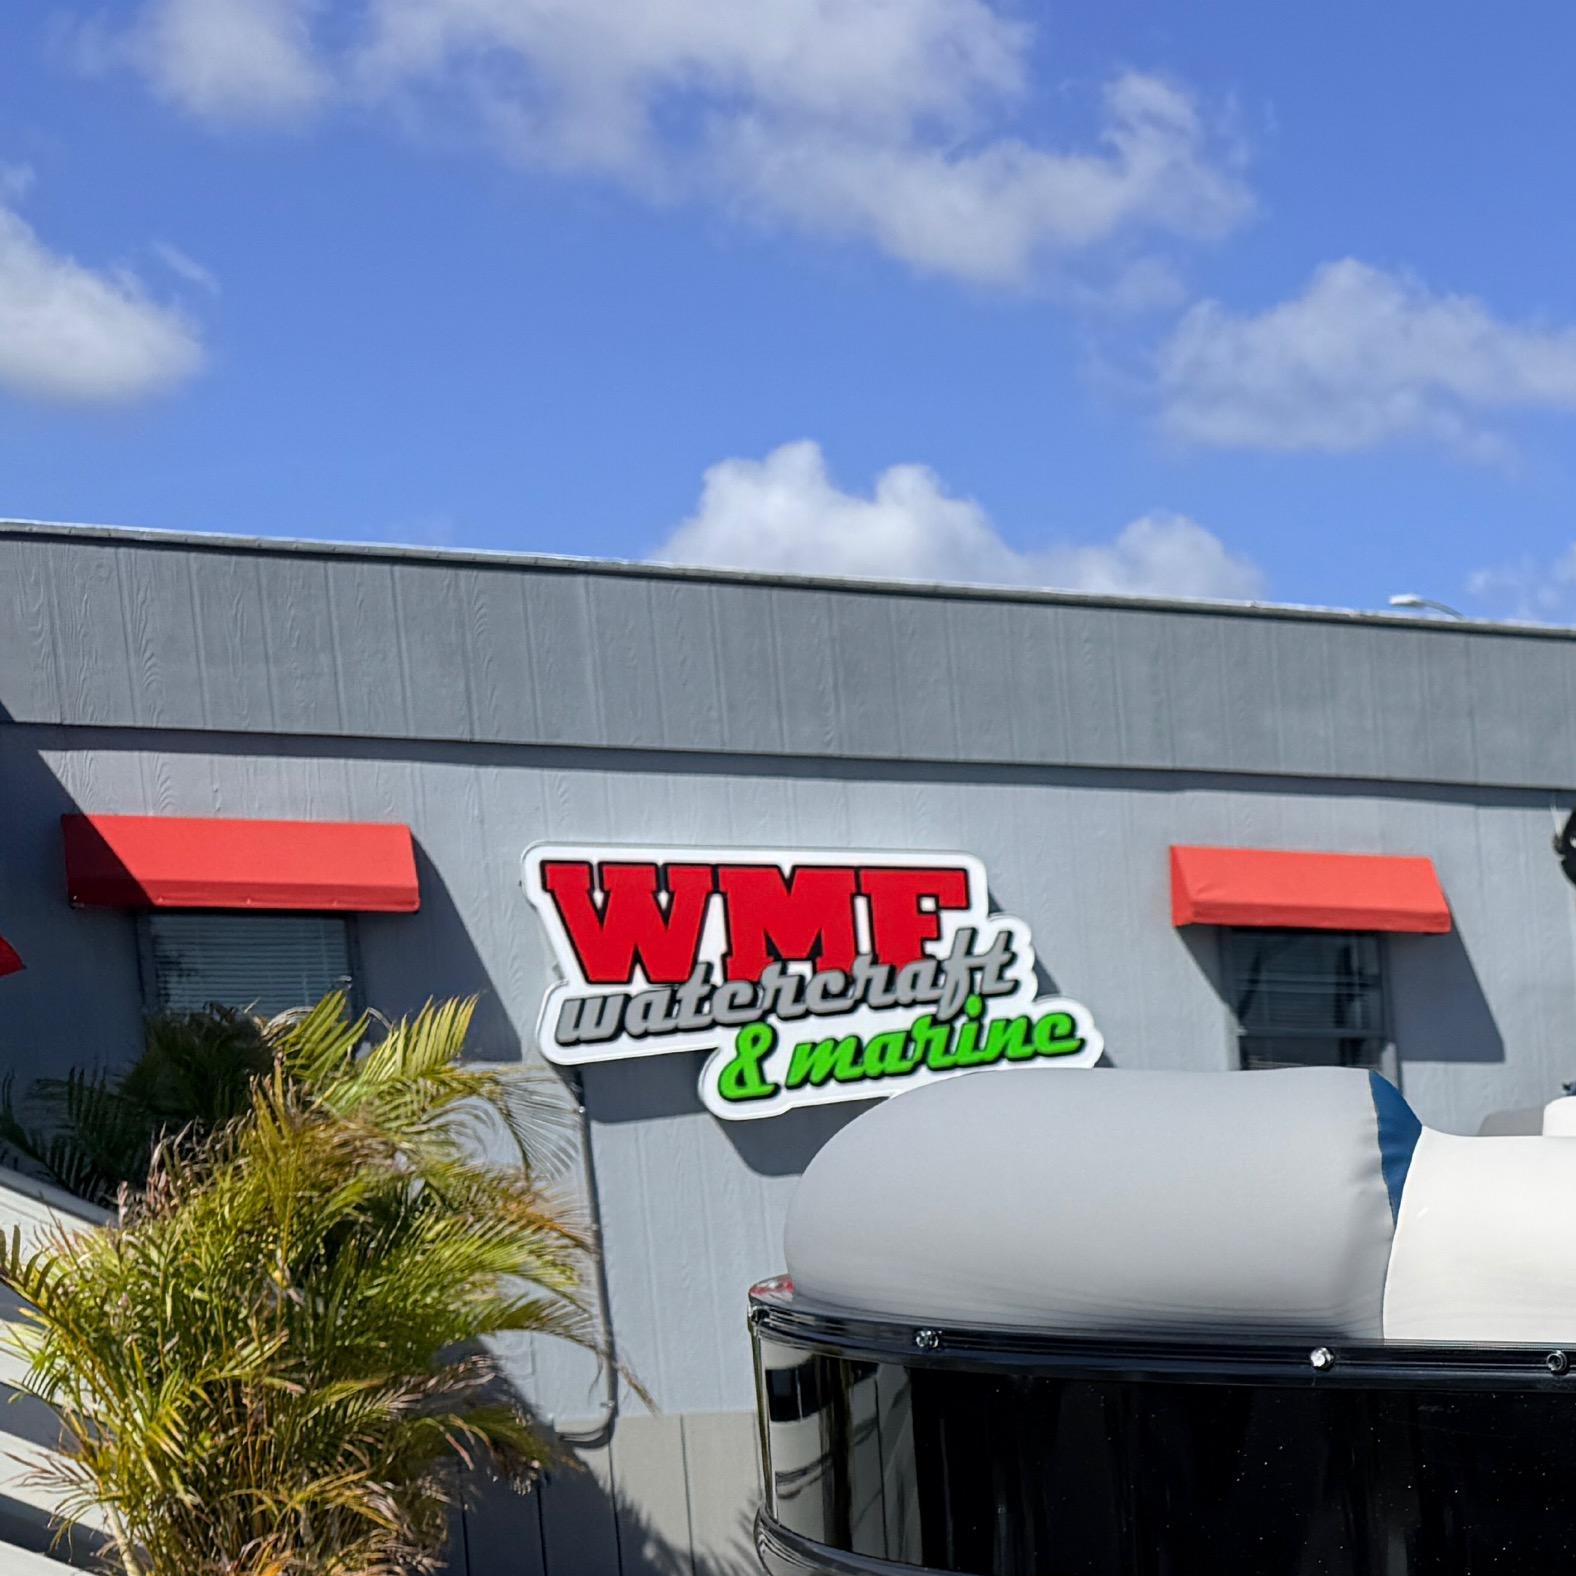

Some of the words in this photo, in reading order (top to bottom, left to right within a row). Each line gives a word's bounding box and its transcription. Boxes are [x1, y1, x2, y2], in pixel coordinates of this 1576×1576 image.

[540, 860, 970, 985] WMF
[554, 926, 1018, 1045] watercraft
[716, 1022, 778, 1101] &
[785, 995, 1085, 1091] marine
